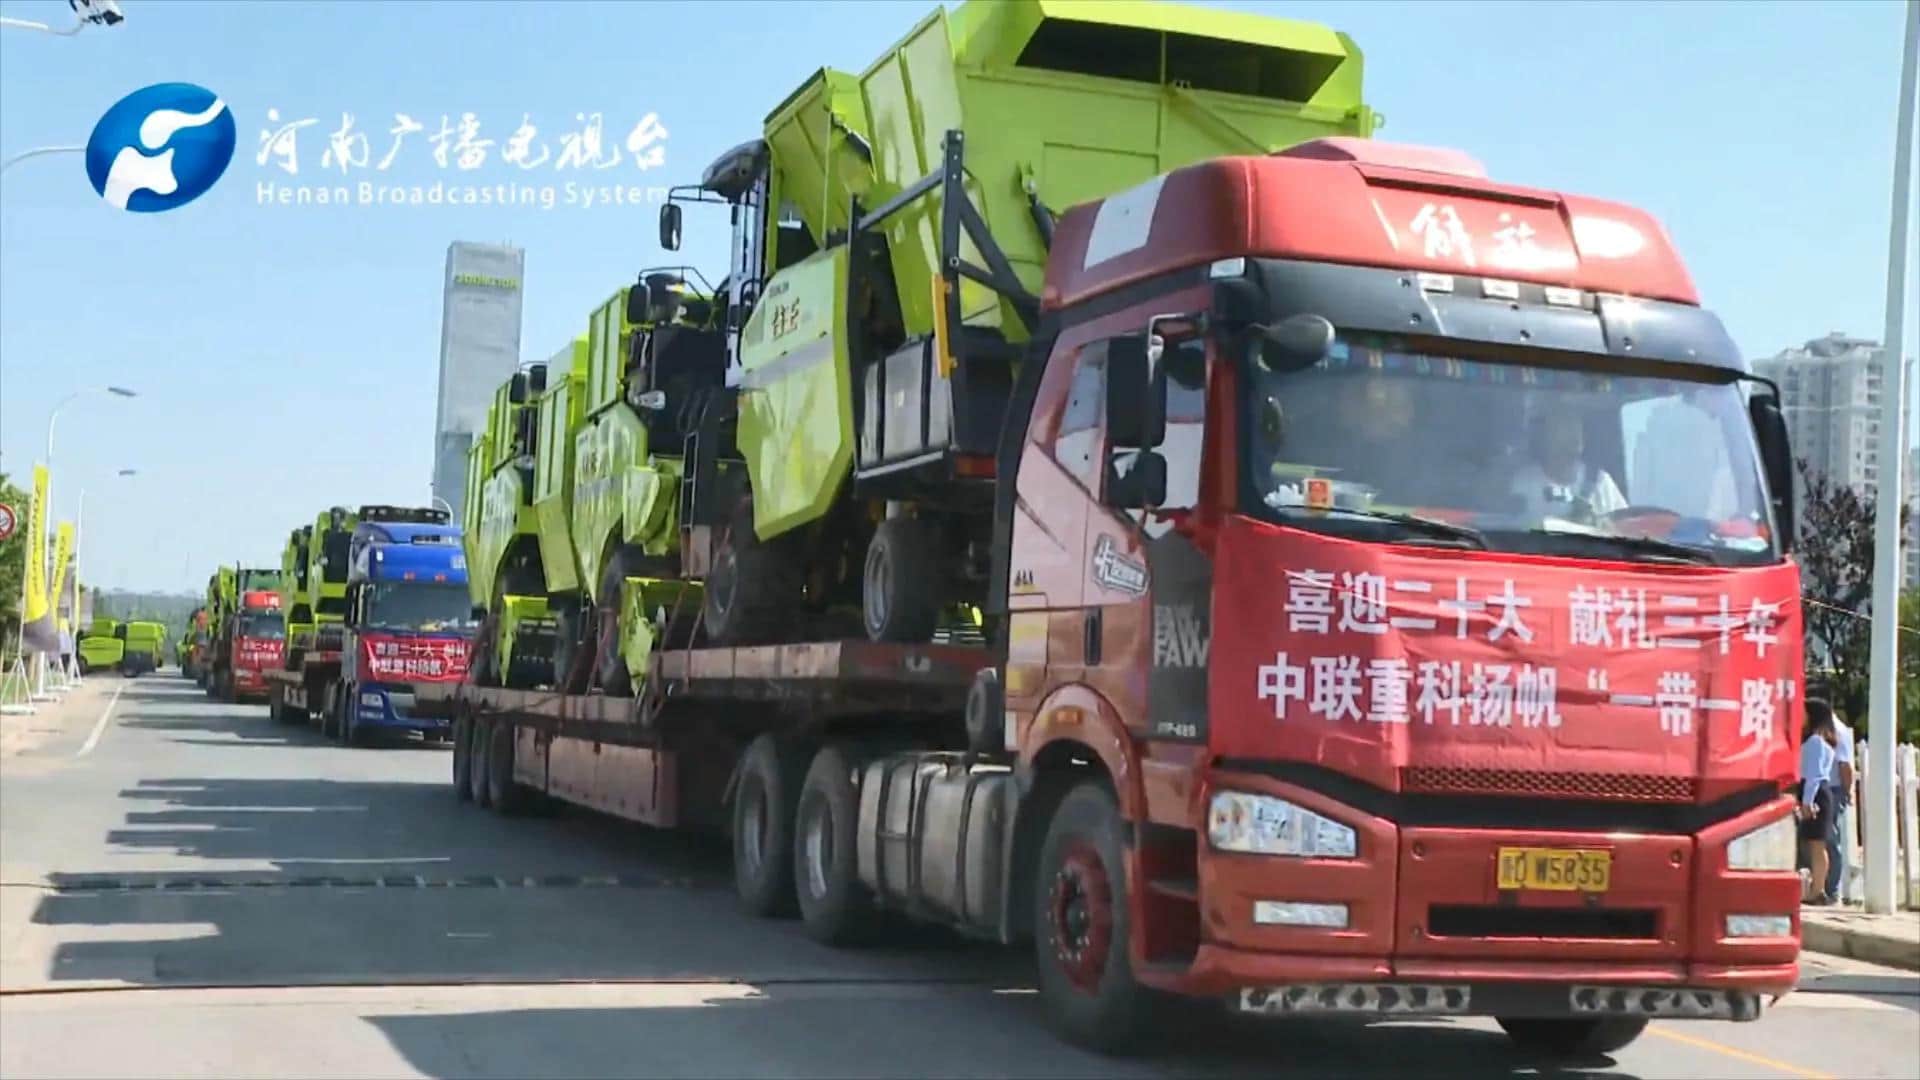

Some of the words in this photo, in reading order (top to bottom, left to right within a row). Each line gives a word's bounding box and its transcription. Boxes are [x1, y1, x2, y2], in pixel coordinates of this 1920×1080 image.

[1284, 569, 1533, 642] 喜迎二十大
[1569, 584, 1780, 658] 献礼三十年
[1154, 637, 1208, 668] FAW
[1258, 651, 1562, 728] 中联重科扬帆
[1535, 856, 1609, 886] W5835
